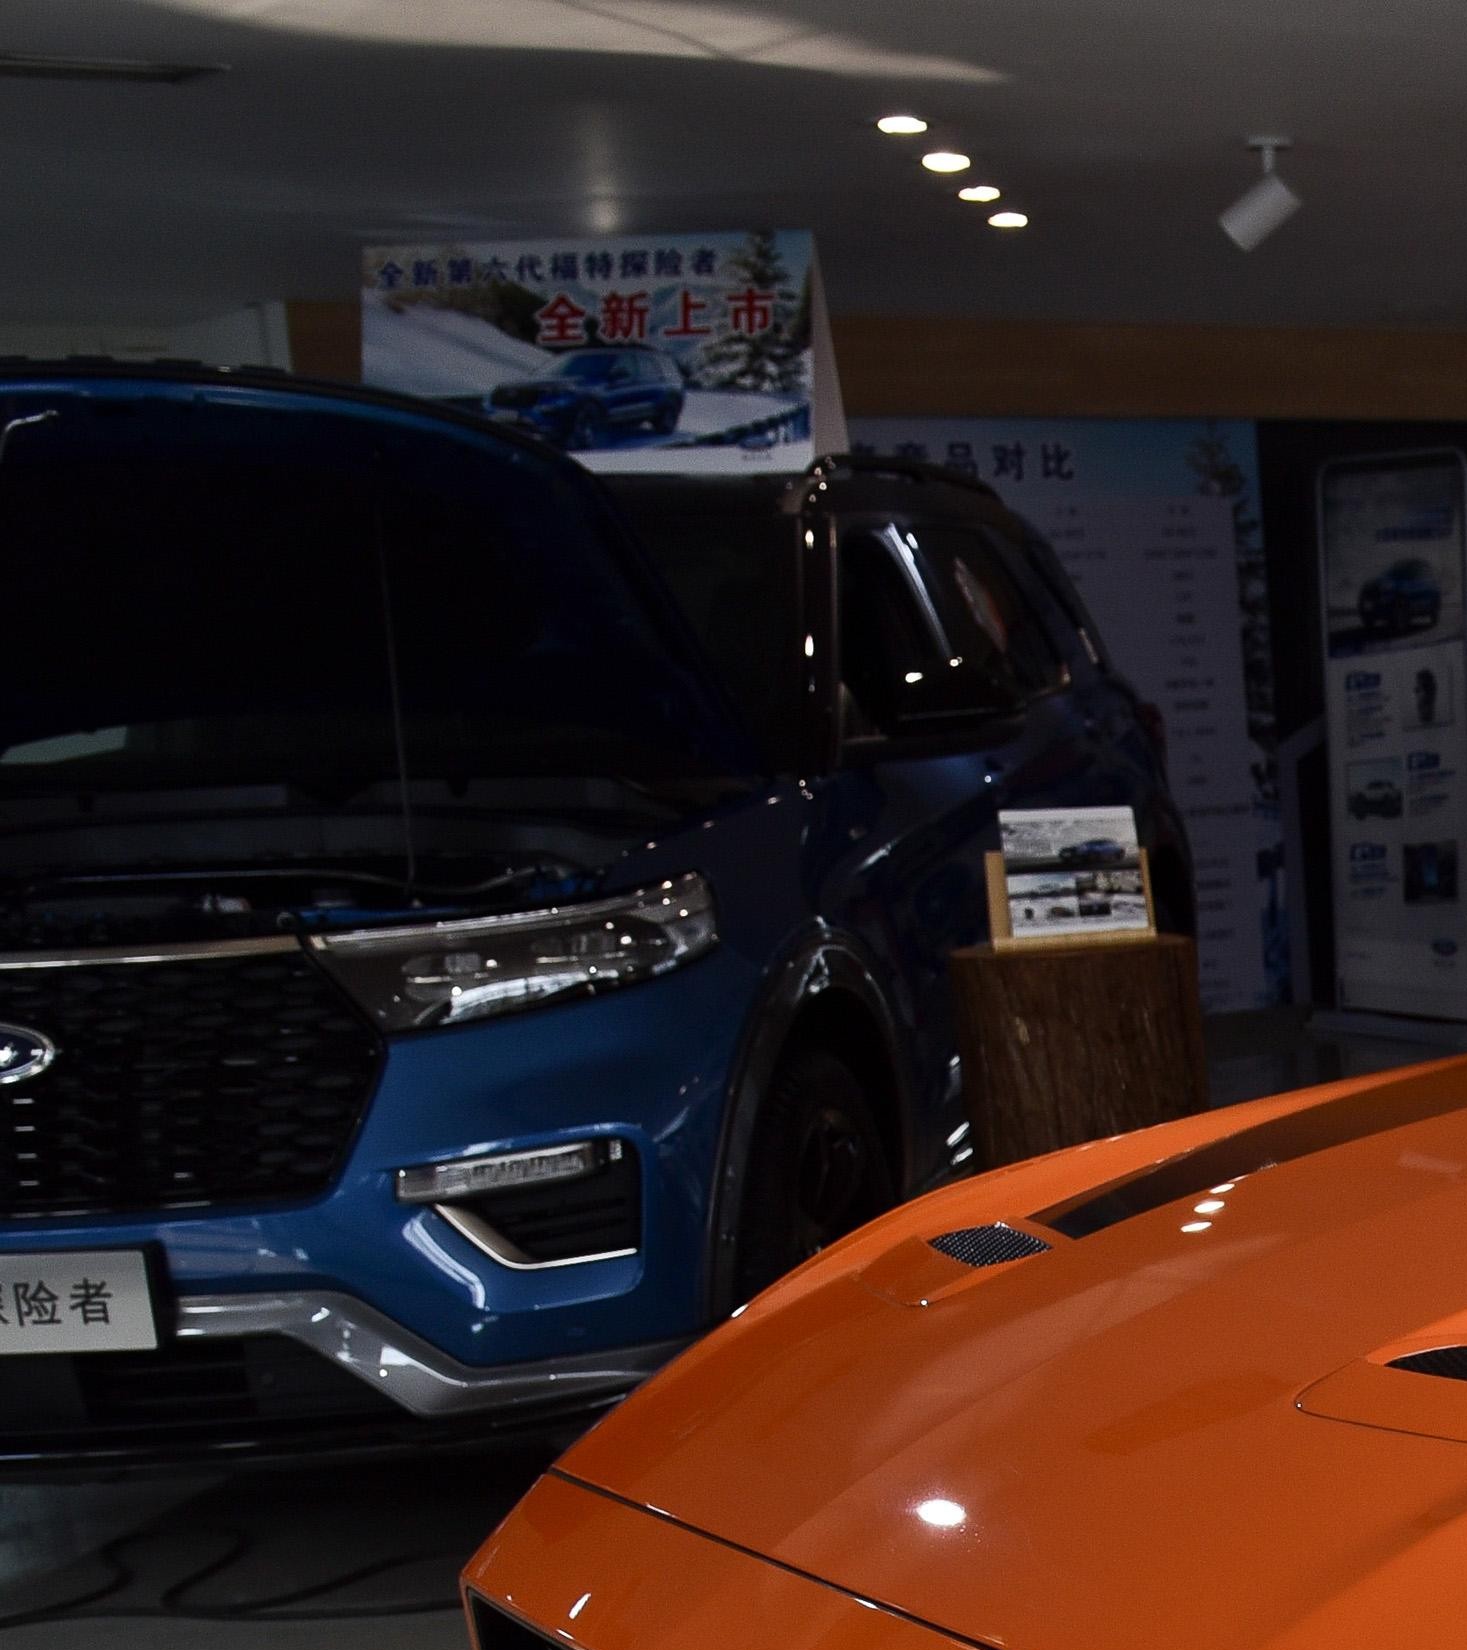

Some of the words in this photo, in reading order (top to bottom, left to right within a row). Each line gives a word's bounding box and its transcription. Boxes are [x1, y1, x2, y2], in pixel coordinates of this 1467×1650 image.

[377, 247, 718, 291] 全新第六代福特探险者
[536, 287, 777, 344] 全新上市
